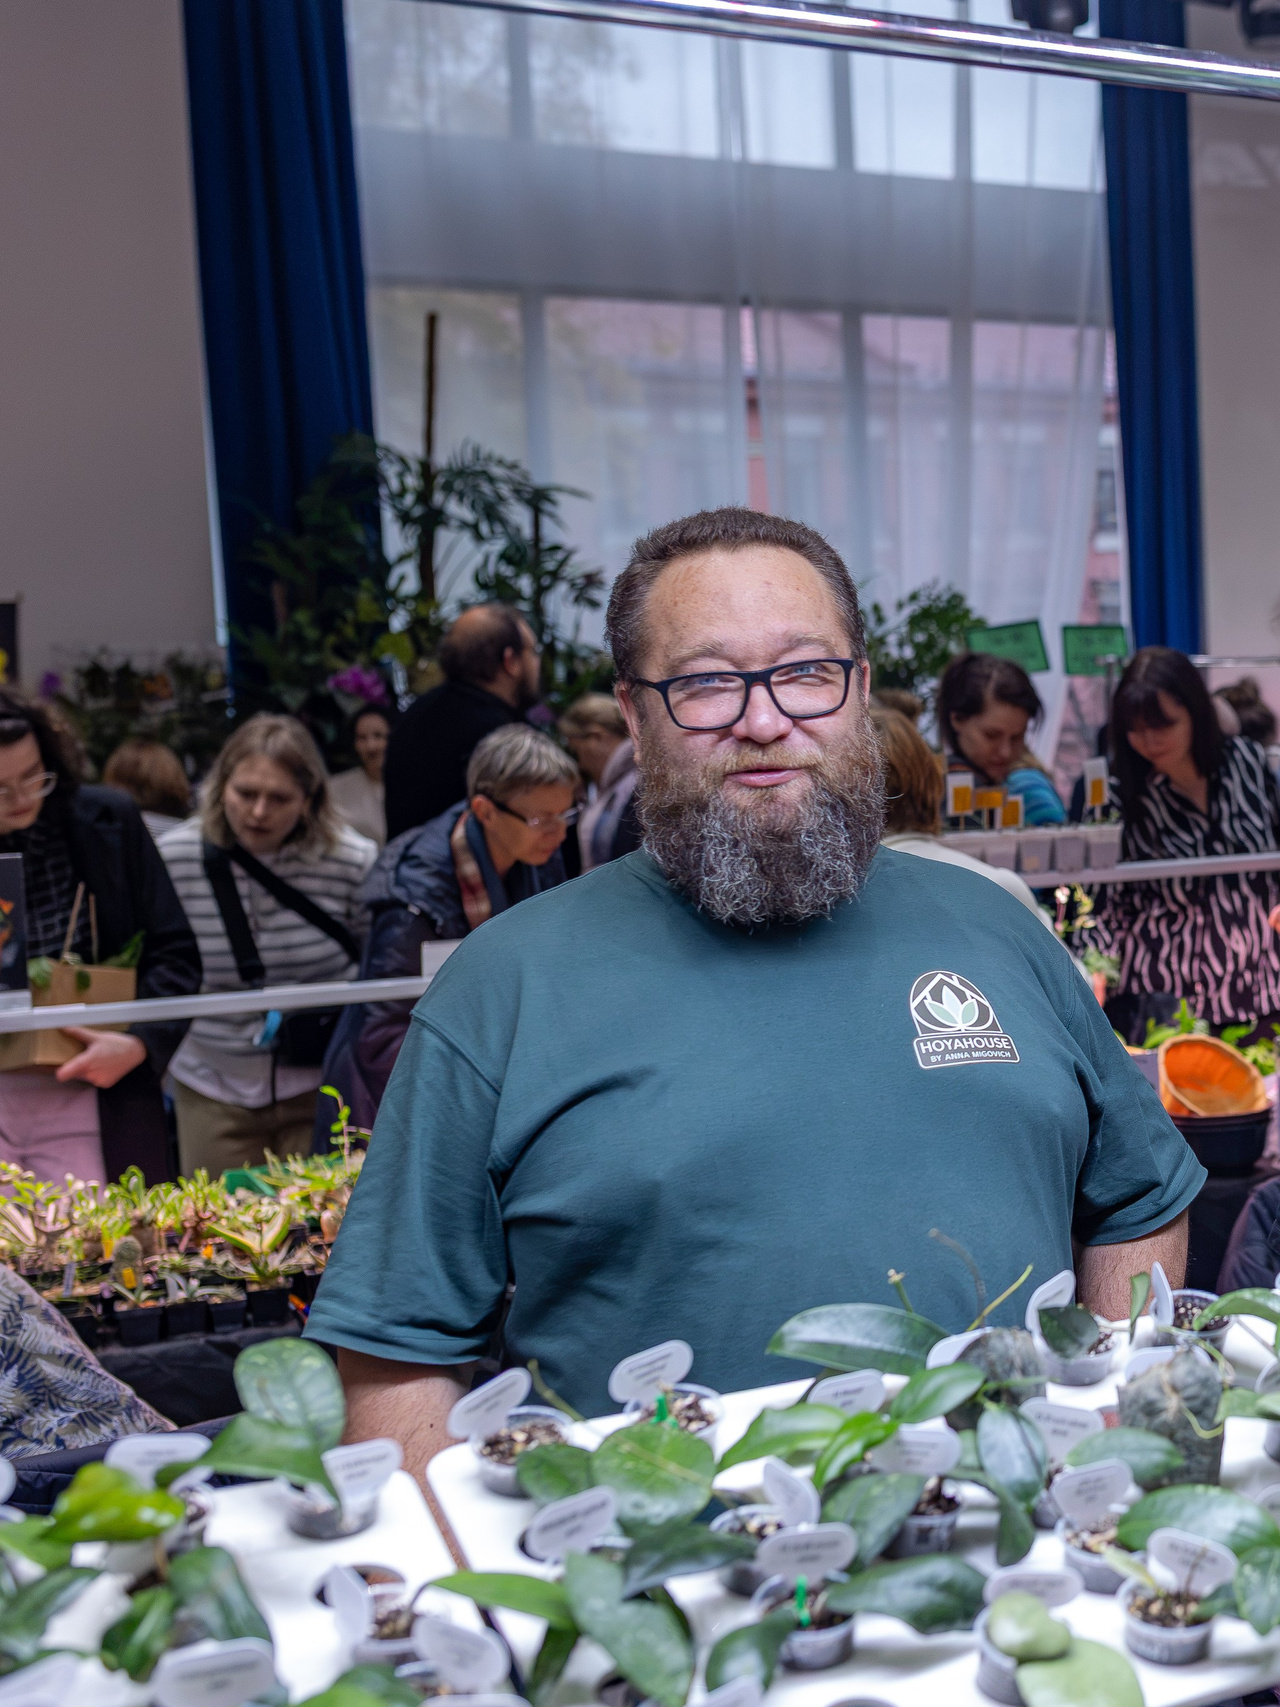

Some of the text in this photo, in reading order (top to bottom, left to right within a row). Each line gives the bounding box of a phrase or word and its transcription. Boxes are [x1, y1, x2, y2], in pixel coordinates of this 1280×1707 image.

[920, 1037, 1011, 1053] HOYAHOUSE
[930, 1051, 1011, 1063] BY ANNA MIGOVICH
